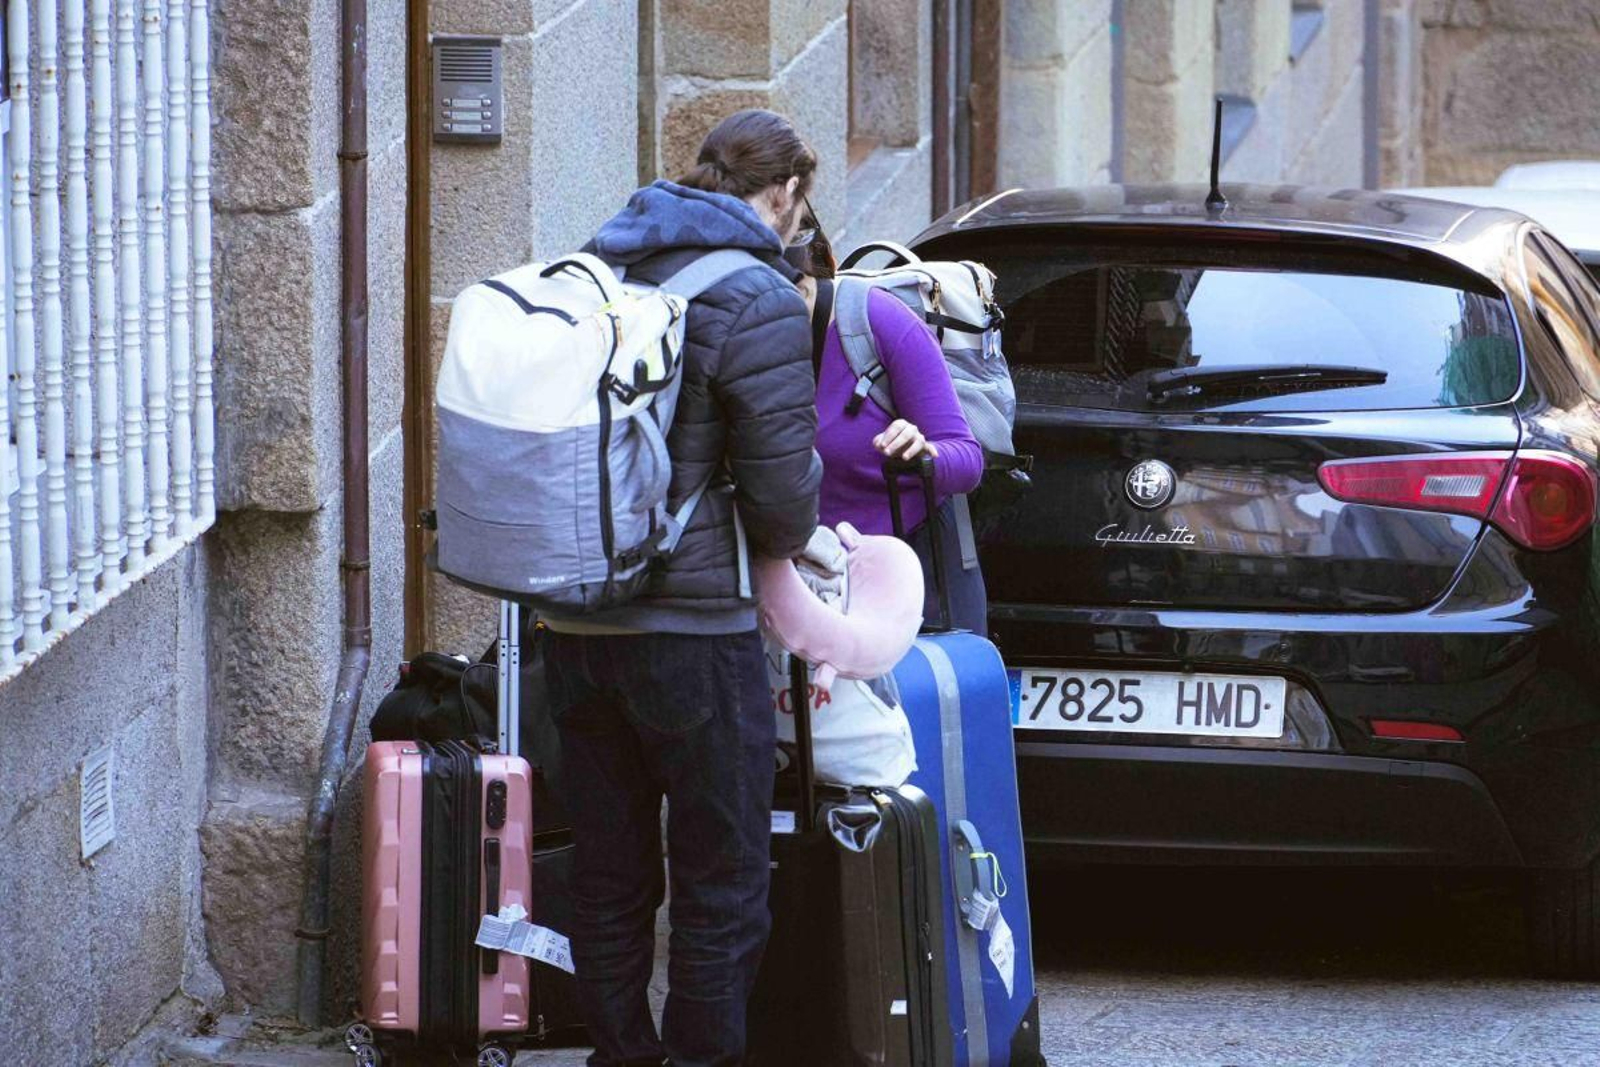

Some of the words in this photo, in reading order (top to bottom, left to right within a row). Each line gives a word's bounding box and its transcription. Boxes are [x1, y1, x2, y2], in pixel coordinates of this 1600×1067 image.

[1095, 523, 1196, 548] Giulietta
[1029, 676, 1143, 723] 7825
[1176, 681, 1261, 728] HMD
